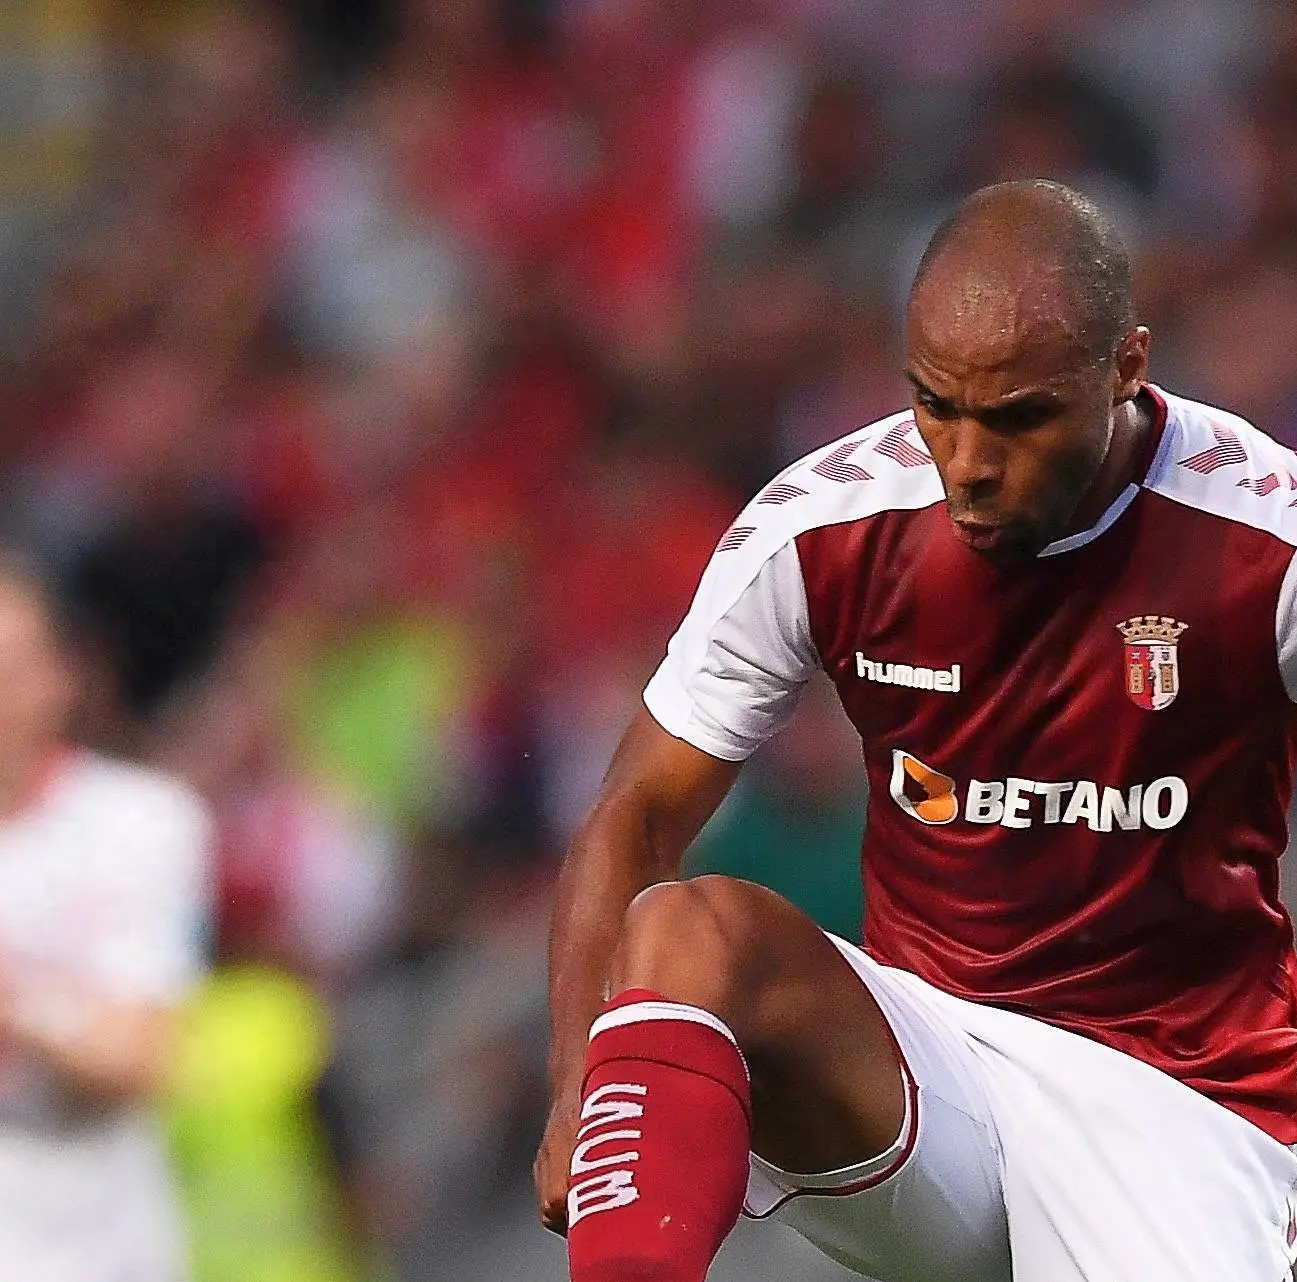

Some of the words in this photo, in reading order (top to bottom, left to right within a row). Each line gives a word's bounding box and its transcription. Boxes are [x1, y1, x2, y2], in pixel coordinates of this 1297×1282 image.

[855, 651, 961, 693] hummel
[964, 775, 1189, 833] BETANO
[568, 1082, 648, 1229] SCB
